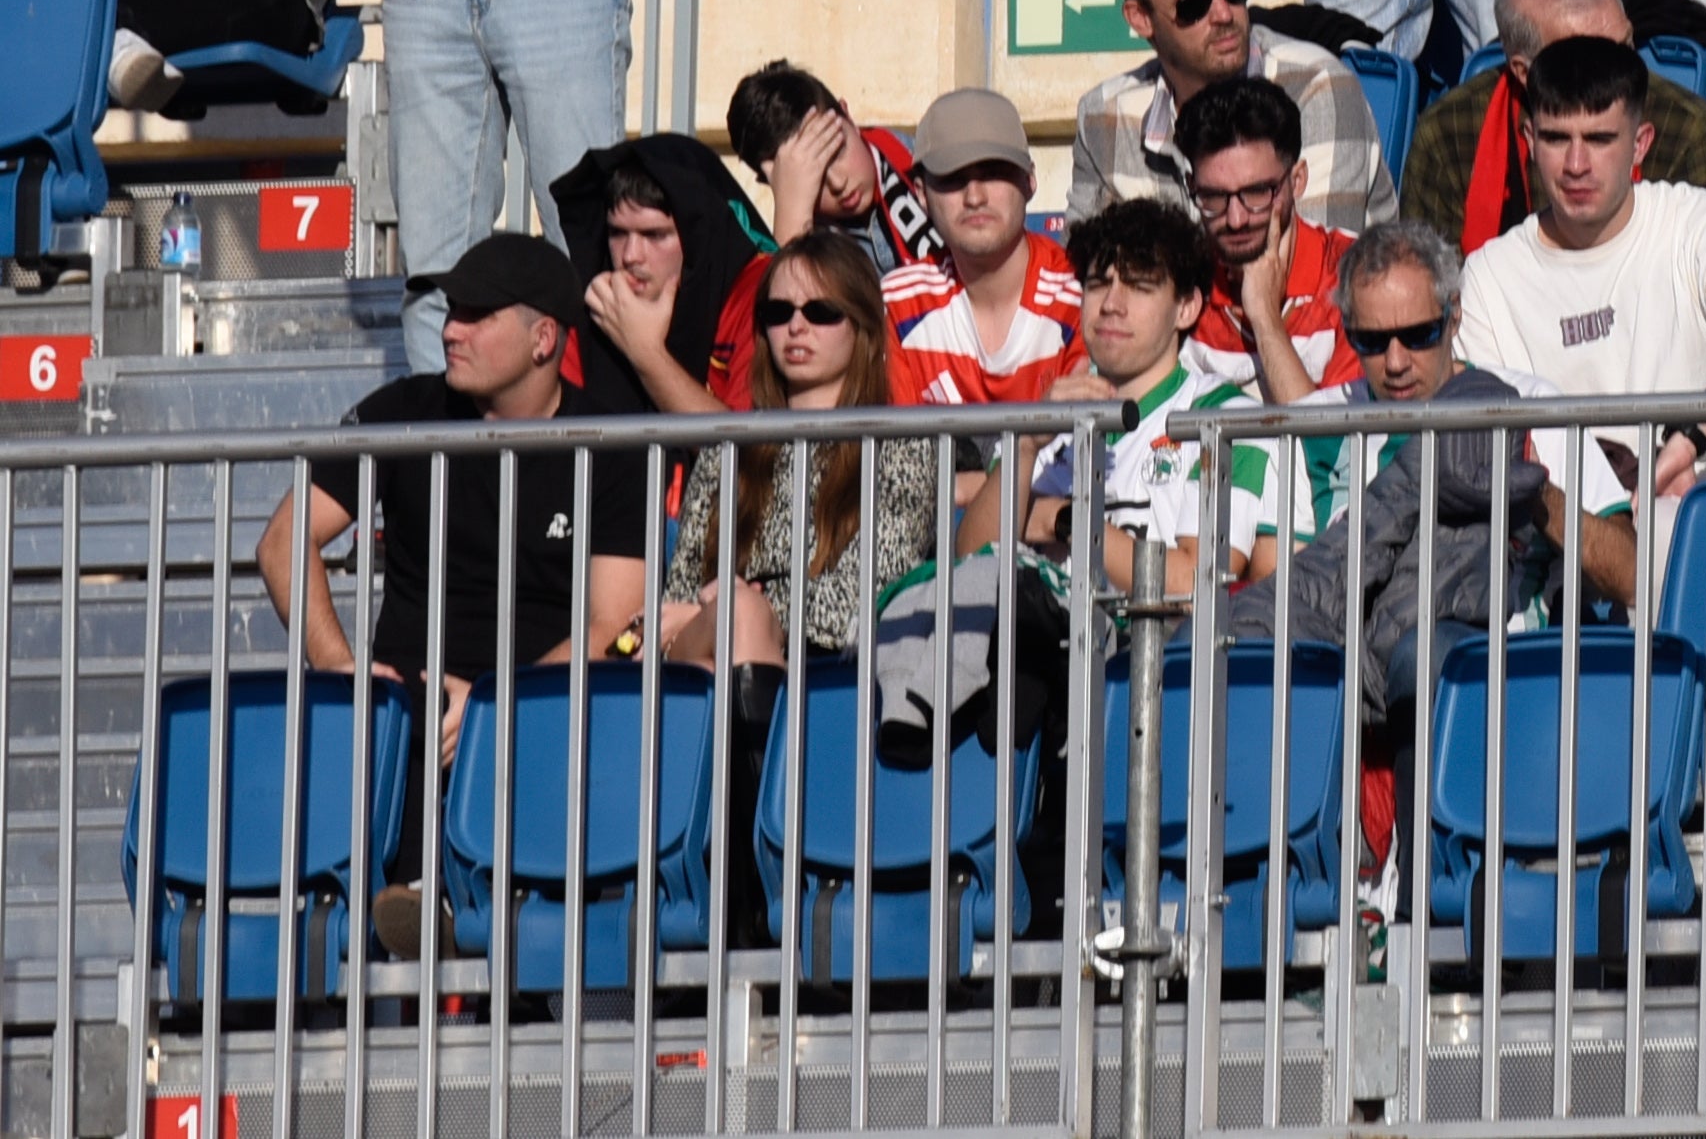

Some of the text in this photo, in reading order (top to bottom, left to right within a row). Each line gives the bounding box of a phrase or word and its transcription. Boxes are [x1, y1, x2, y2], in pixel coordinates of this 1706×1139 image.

[292, 195, 320, 242] 7
[1559, 304, 1615, 348] HUF
[29, 344, 57, 392] 6
[177, 1104, 198, 1139] 1
